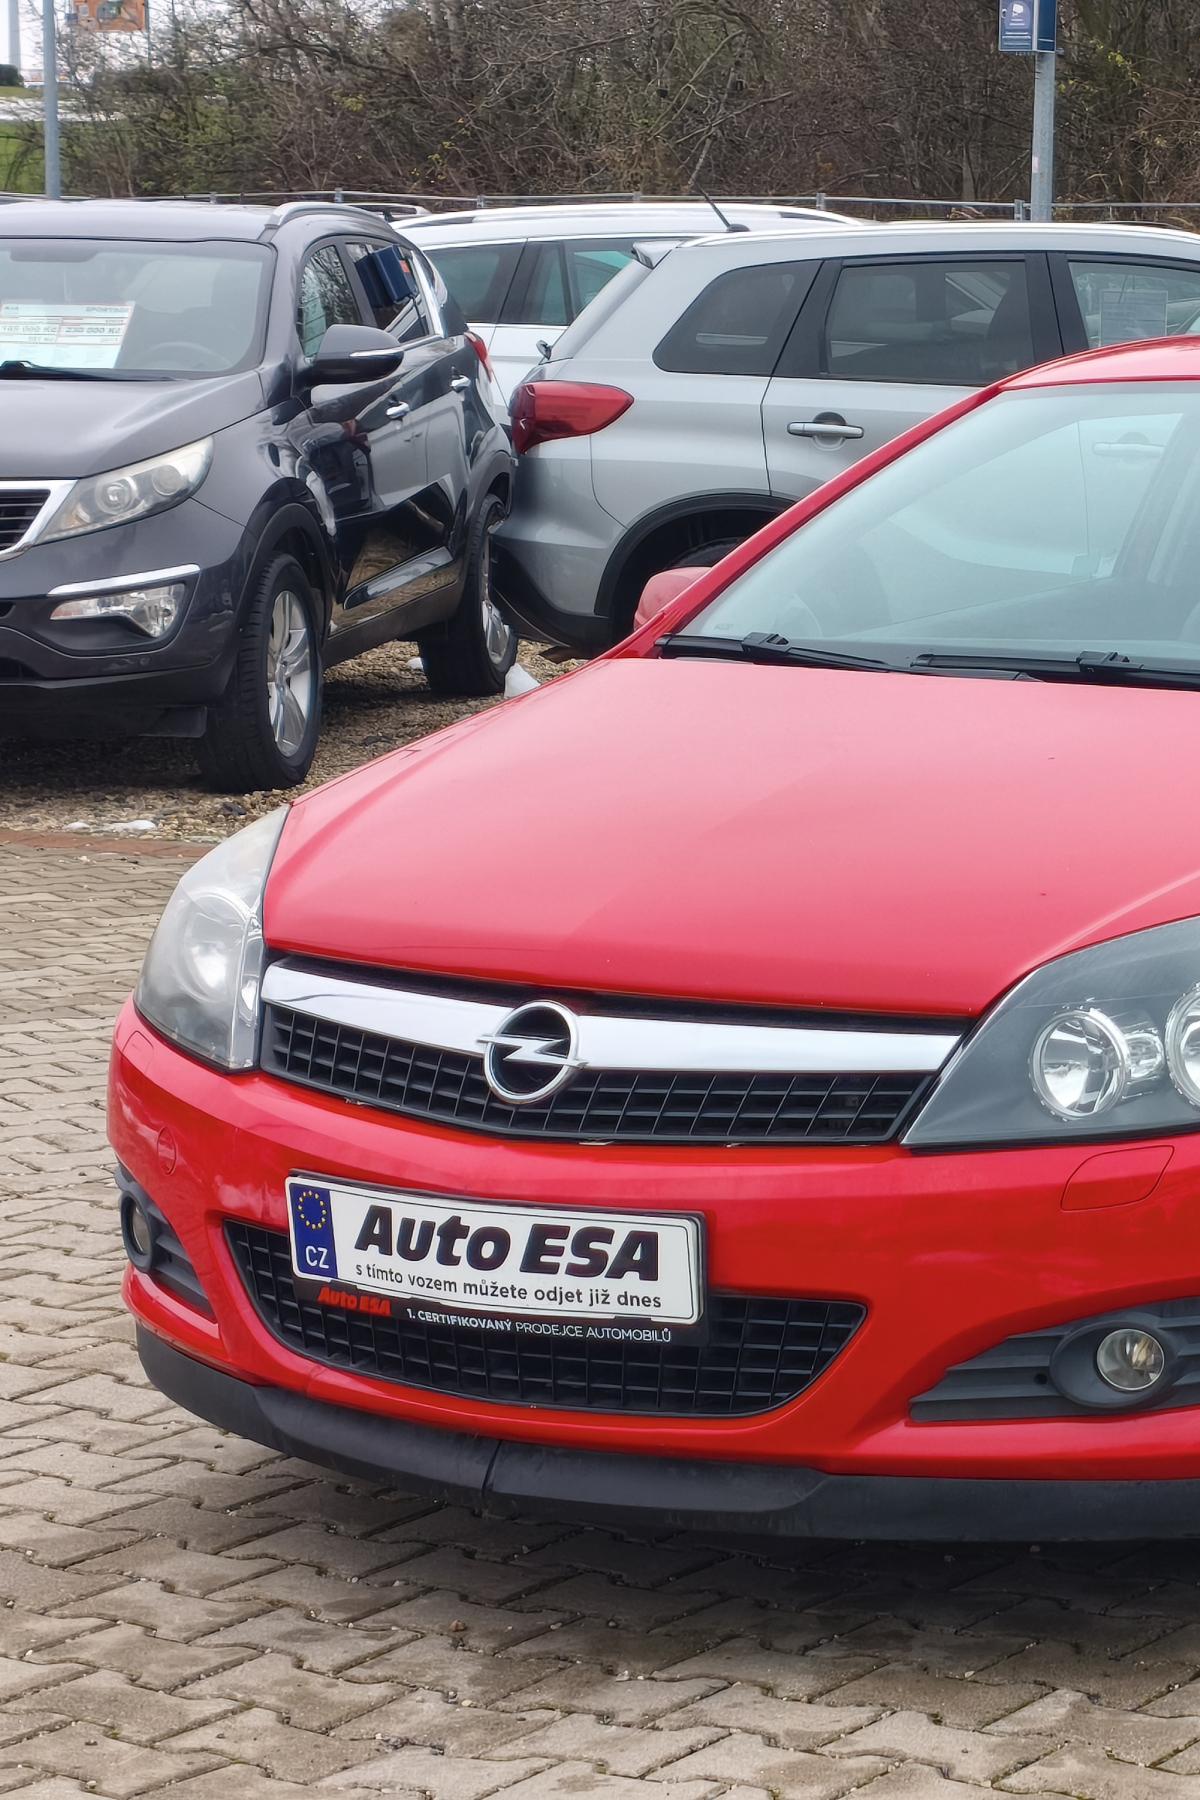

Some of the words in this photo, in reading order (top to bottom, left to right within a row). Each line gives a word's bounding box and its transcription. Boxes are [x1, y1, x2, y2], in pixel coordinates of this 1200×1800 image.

[304, 1245, 330, 1269] CZ
[354, 1204, 511, 1272] Auto
[519, 1223, 659, 1282] ESA
[316, 1284, 358, 1307] Auto
[358, 1296, 392, 1317] ESA
[355, 1263, 363, 1276] s
[366, 1262, 404, 1284] tímto
[407, 1273, 458, 1293] vozem
[463, 1279, 528, 1301] můžete
[534, 1286, 584, 1306] odjet
[588, 1289, 611, 1307] již
[617, 1291, 662, 1309] dnes
[406, 1307, 416, 1320] 1.
[417, 1311, 512, 1332] CERTIFIKOVANÝ
[515, 1321, 584, 1337] PRODEJCE
[585, 1326, 672, 1343] AUTOMOBILŮ
